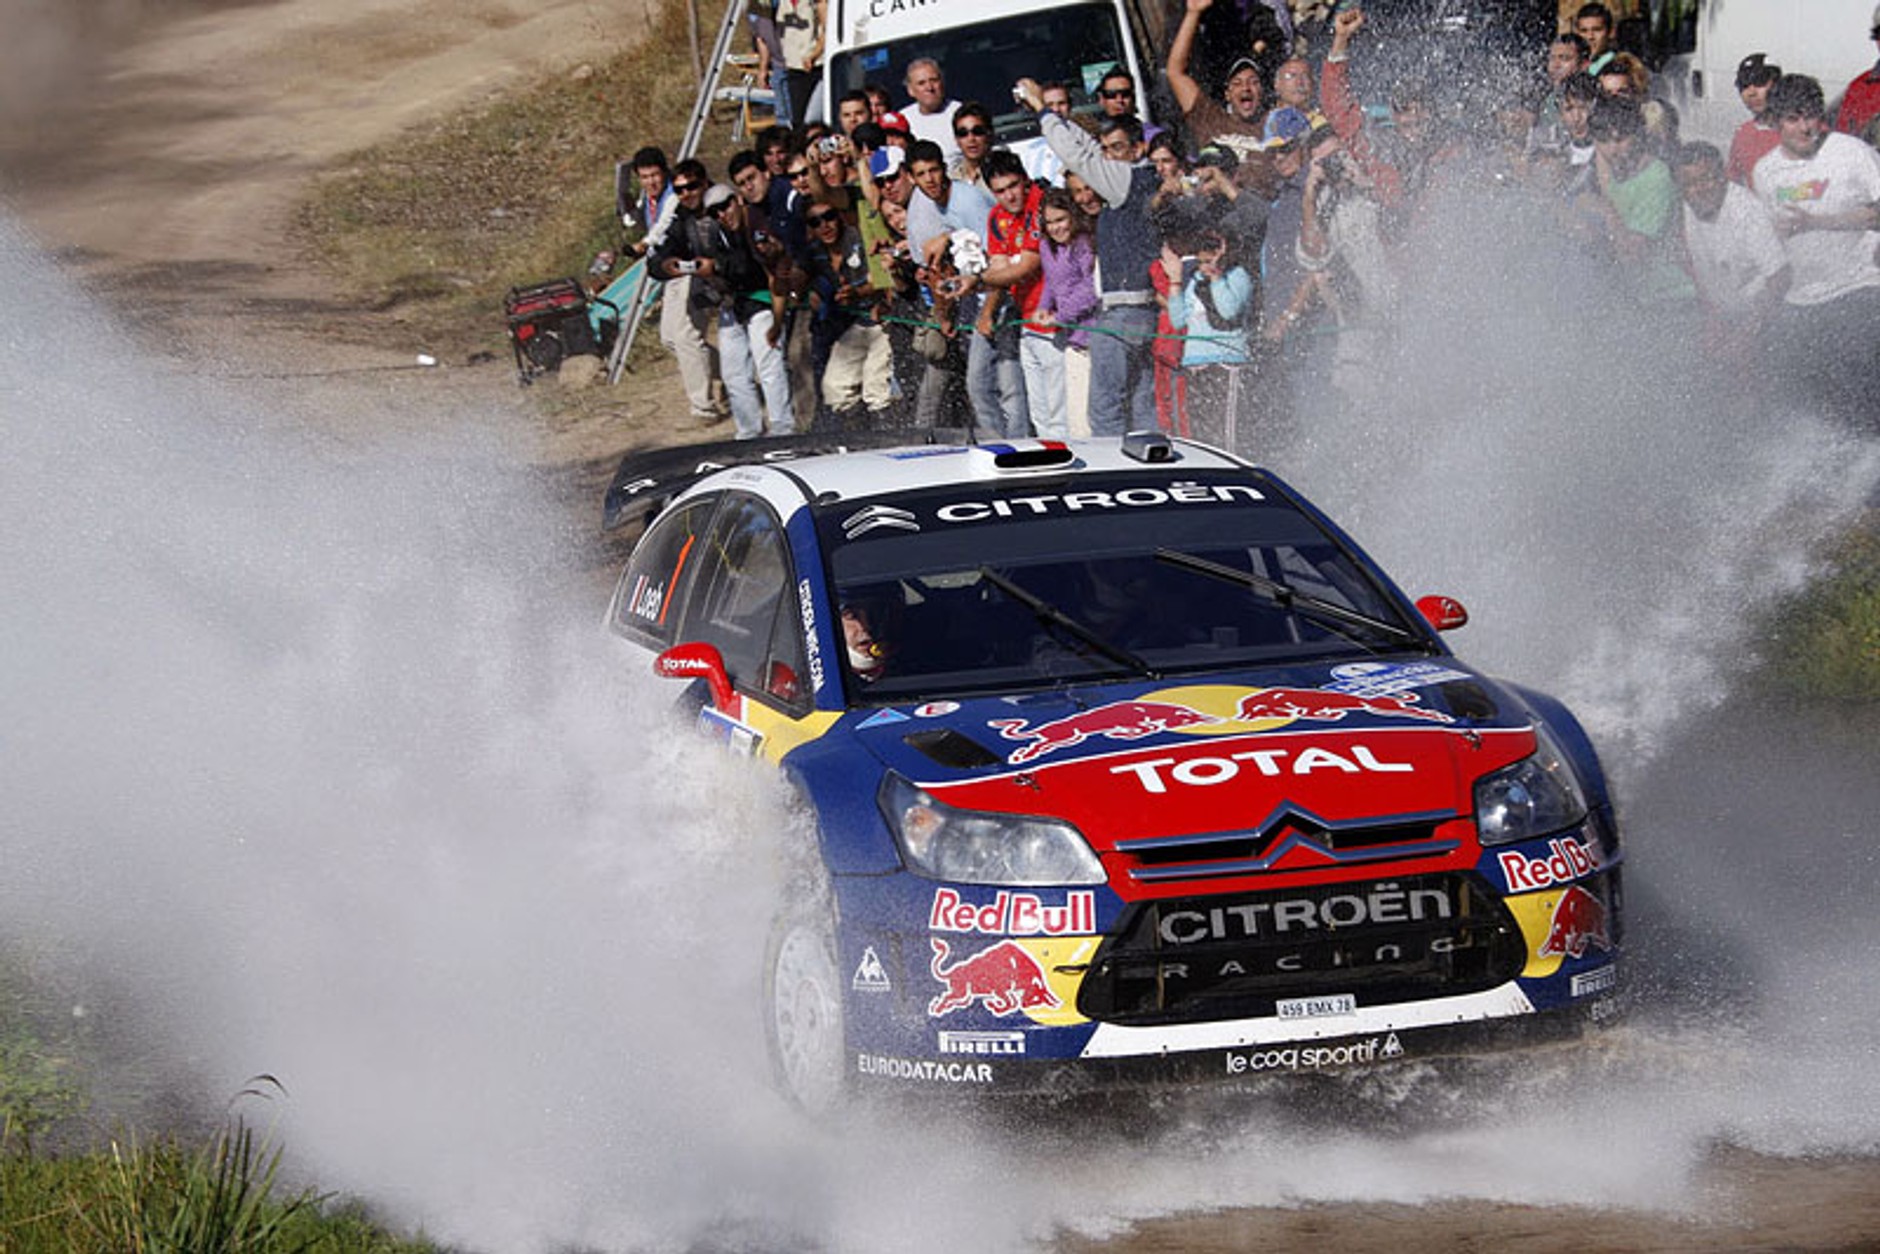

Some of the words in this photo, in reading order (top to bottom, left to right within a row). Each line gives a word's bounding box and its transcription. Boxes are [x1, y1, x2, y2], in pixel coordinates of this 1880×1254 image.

[662, 658, 712, 670] TOTAL
[1109, 745, 1414, 793] TOTAL
[1498, 837, 1574, 893] Red
[930, 888, 1008, 933] Red
[1009, 890, 1096, 935] Bull
[938, 1031, 1025, 1053] PIRELLI
[1226, 1052, 1247, 1074] le
[1250, 1050, 1298, 1070] coq
[1301, 1038, 1379, 1068] sportif
[858, 1053, 993, 1082] EURODATACAR
